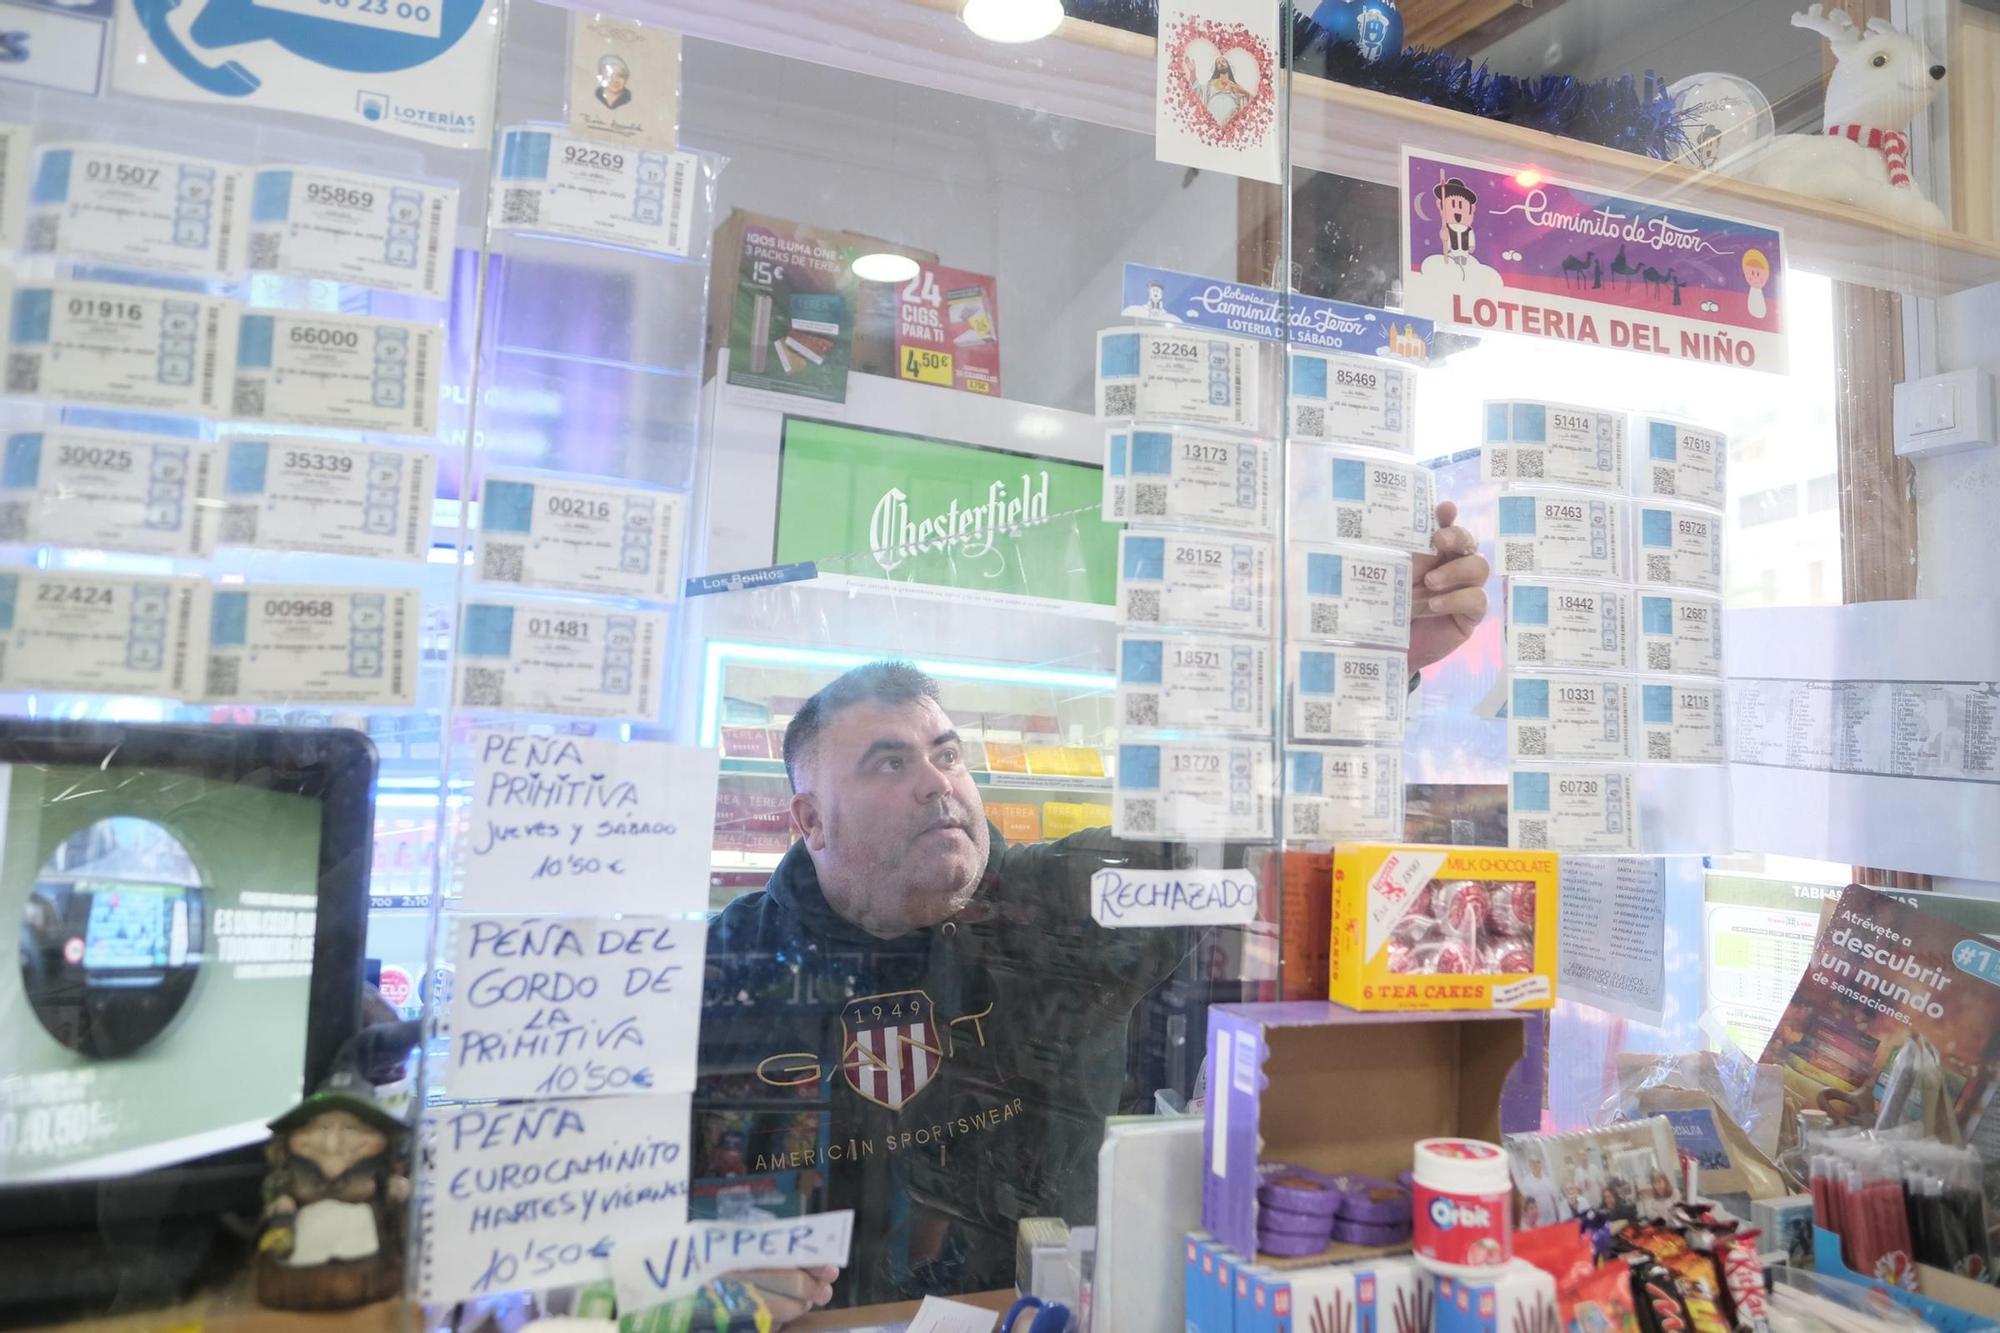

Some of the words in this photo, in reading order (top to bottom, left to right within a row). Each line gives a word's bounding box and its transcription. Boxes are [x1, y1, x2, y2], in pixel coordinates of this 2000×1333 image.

[397, 2, 431, 22] 00
[393, 105, 476, 128] LOTERÍAS
[564, 145, 625, 169] 92269
[86, 160, 160, 185] 01507
[307, 183, 374, 208] 95869
[1505, 190, 1621, 239] Caminito
[1622, 221, 1650, 244] de
[1648, 217, 1712, 252] Teror
[902, 271, 942, 308] 24
[68, 298, 143, 321] 01916
[902, 303, 944, 329] CIGS.
[902, 322, 929, 341] PARA
[1227, 318, 1274, 336] LOTERIA
[1297, 329, 1343, 348] SÁBADO
[1291, 308, 1312, 327] de
[1314, 309, 1368, 336] Teror
[1453, 294, 1600, 344] LOTERIA
[1610, 319, 1670, 354] DEL
[1681, 331, 1756, 367] NIÑO
[290, 326, 359, 348] 66000
[1151, 341, 1198, 359] 32264
[1337, 369, 1377, 388] 85469
[1554, 414, 1590, 430] 51414
[1183, 444, 1228, 462] 13173
[1682, 435, 1711, 452] 47619
[59, 444, 134, 470] 30025
[284, 451, 354, 473] 35339
[1374, 471, 1408, 488] 39258
[548, 496, 610, 519] 00216
[1545, 505, 1583, 519] 87463
[868, 471, 1050, 577] Chesterfield
[1679, 520, 1708, 536] 69728
[1176, 547, 1223, 565] 26152
[702, 576, 730, 590] Los
[732, 568, 785, 587] Bonitos
[1351, 564, 1388, 581] 14267
[37, 583, 114, 606] 22424
[1557, 595, 1594, 611] 18442
[264, 600, 334, 619] 00968
[528, 618, 590, 639] 01481
[1175, 650, 1221, 666] 18571
[1343, 661, 1380, 677] 87856
[1559, 688, 1596, 702] 10331
[483, 734, 583, 768] PEÑA
[1173, 754, 1220, 769] 13770
[1560, 780, 1598, 794] 60730
[1447, 857, 1476, 872] MILK
[1479, 858, 1552, 873] CHOCOLATE
[1095, 868, 1257, 919] RECHAZADO
[469, 919, 583, 958] PEÑA
[598, 928, 676, 955] DEL
[1842, 909, 1900, 942] Atrévete
[1902, 936, 1912, 948] a
[1832, 928, 1952, 991] descubrir
[468, 968, 598, 1008] GORDO
[625, 966, 683, 997] DE
[1363, 985, 1373, 999] 6
[1379, 985, 1419, 999] TEA
[1424, 984, 1485, 999] CAKES
[1821, 952, 1850, 977] un
[1855, 969, 1945, 1019] mundo
[1812, 971, 1829, 986] de
[1830, 982, 1913, 1027] sensaciones.
[525, 1008, 570, 1030] LA
[854, 1001, 921, 1024] 1949
[448, 1105, 585, 1152] PEÑA
[887, 1098, 1023, 1151] SPORTSWEAR
[450, 1135, 680, 1198] EUROCAMINITO
[470, 1190, 576, 1234] MARTES
[1428, 1196, 1491, 1230] Orbit
